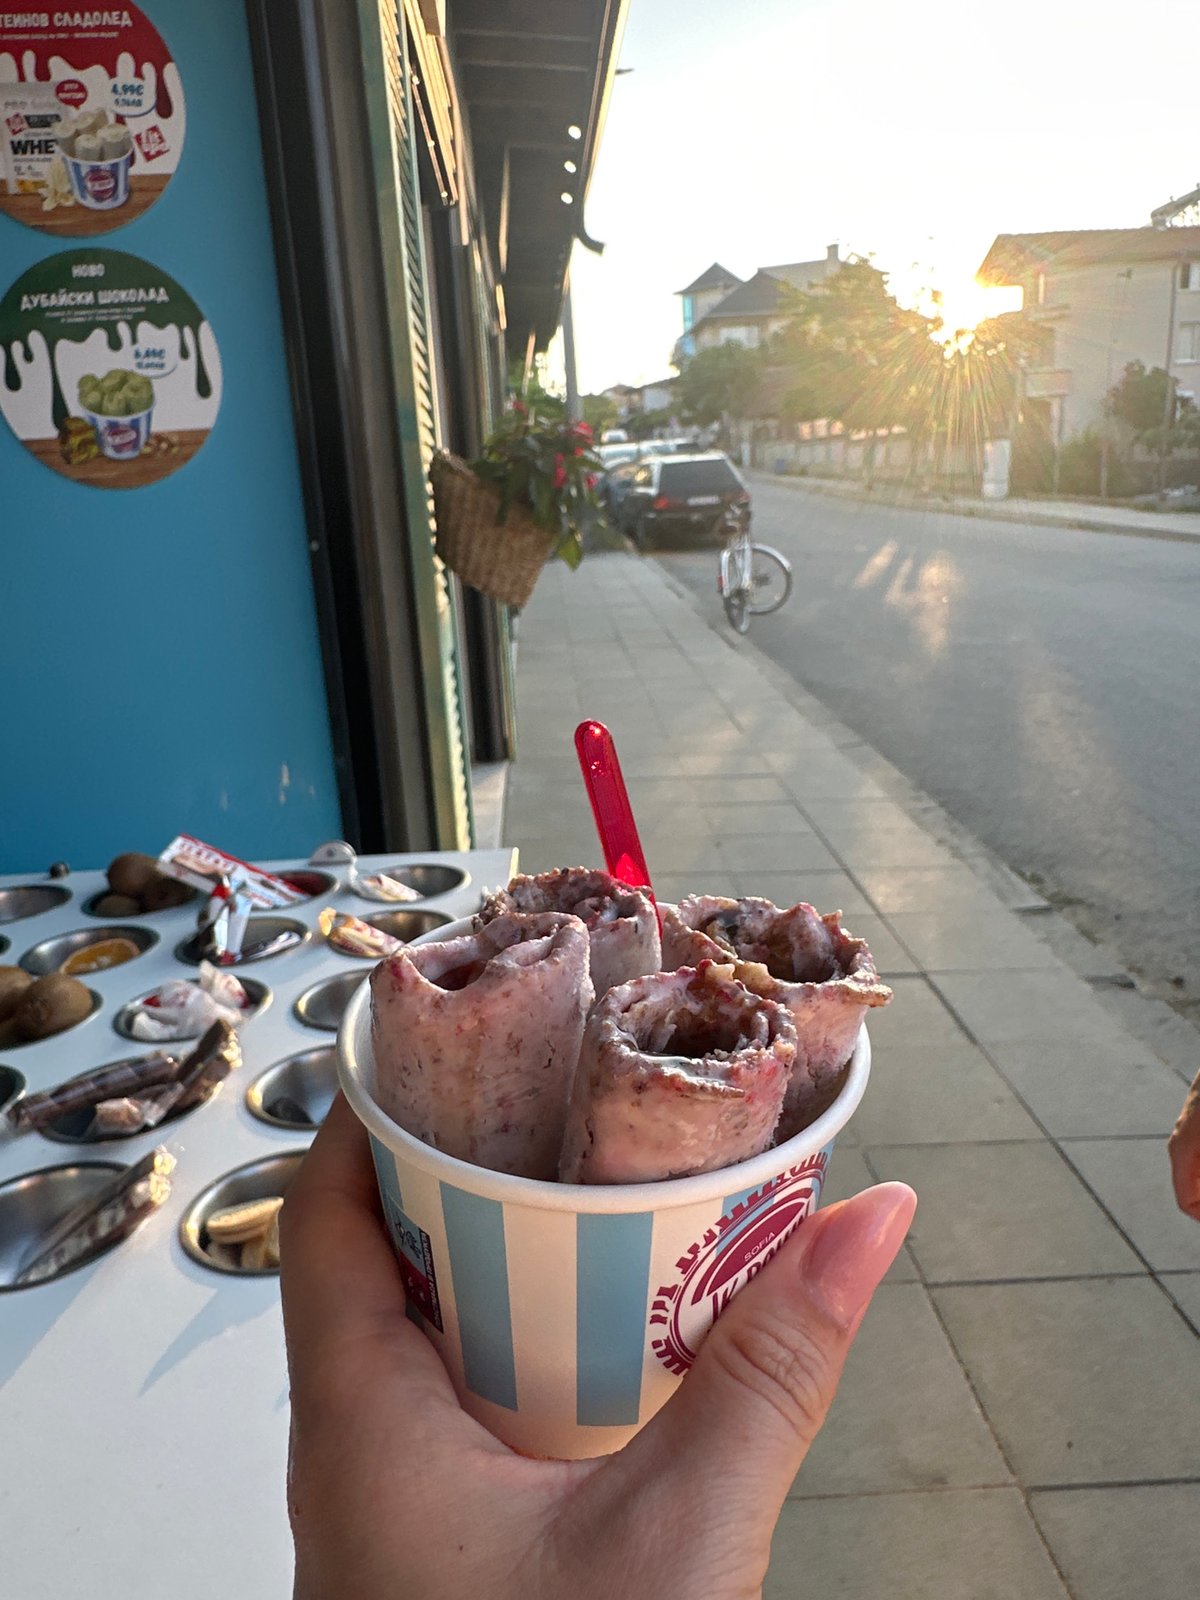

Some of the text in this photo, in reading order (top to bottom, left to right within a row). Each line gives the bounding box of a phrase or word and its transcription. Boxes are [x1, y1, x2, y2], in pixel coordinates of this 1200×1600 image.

[53, 10, 133, 29] СЛАДОЛЕД
[71, 263, 105, 279] НОВО
[20, 288, 95, 312] ДУБАЙСКИ
[97, 286, 170, 306] ШОКОЛАД
[744, 1231, 776, 1262] SOFIA
